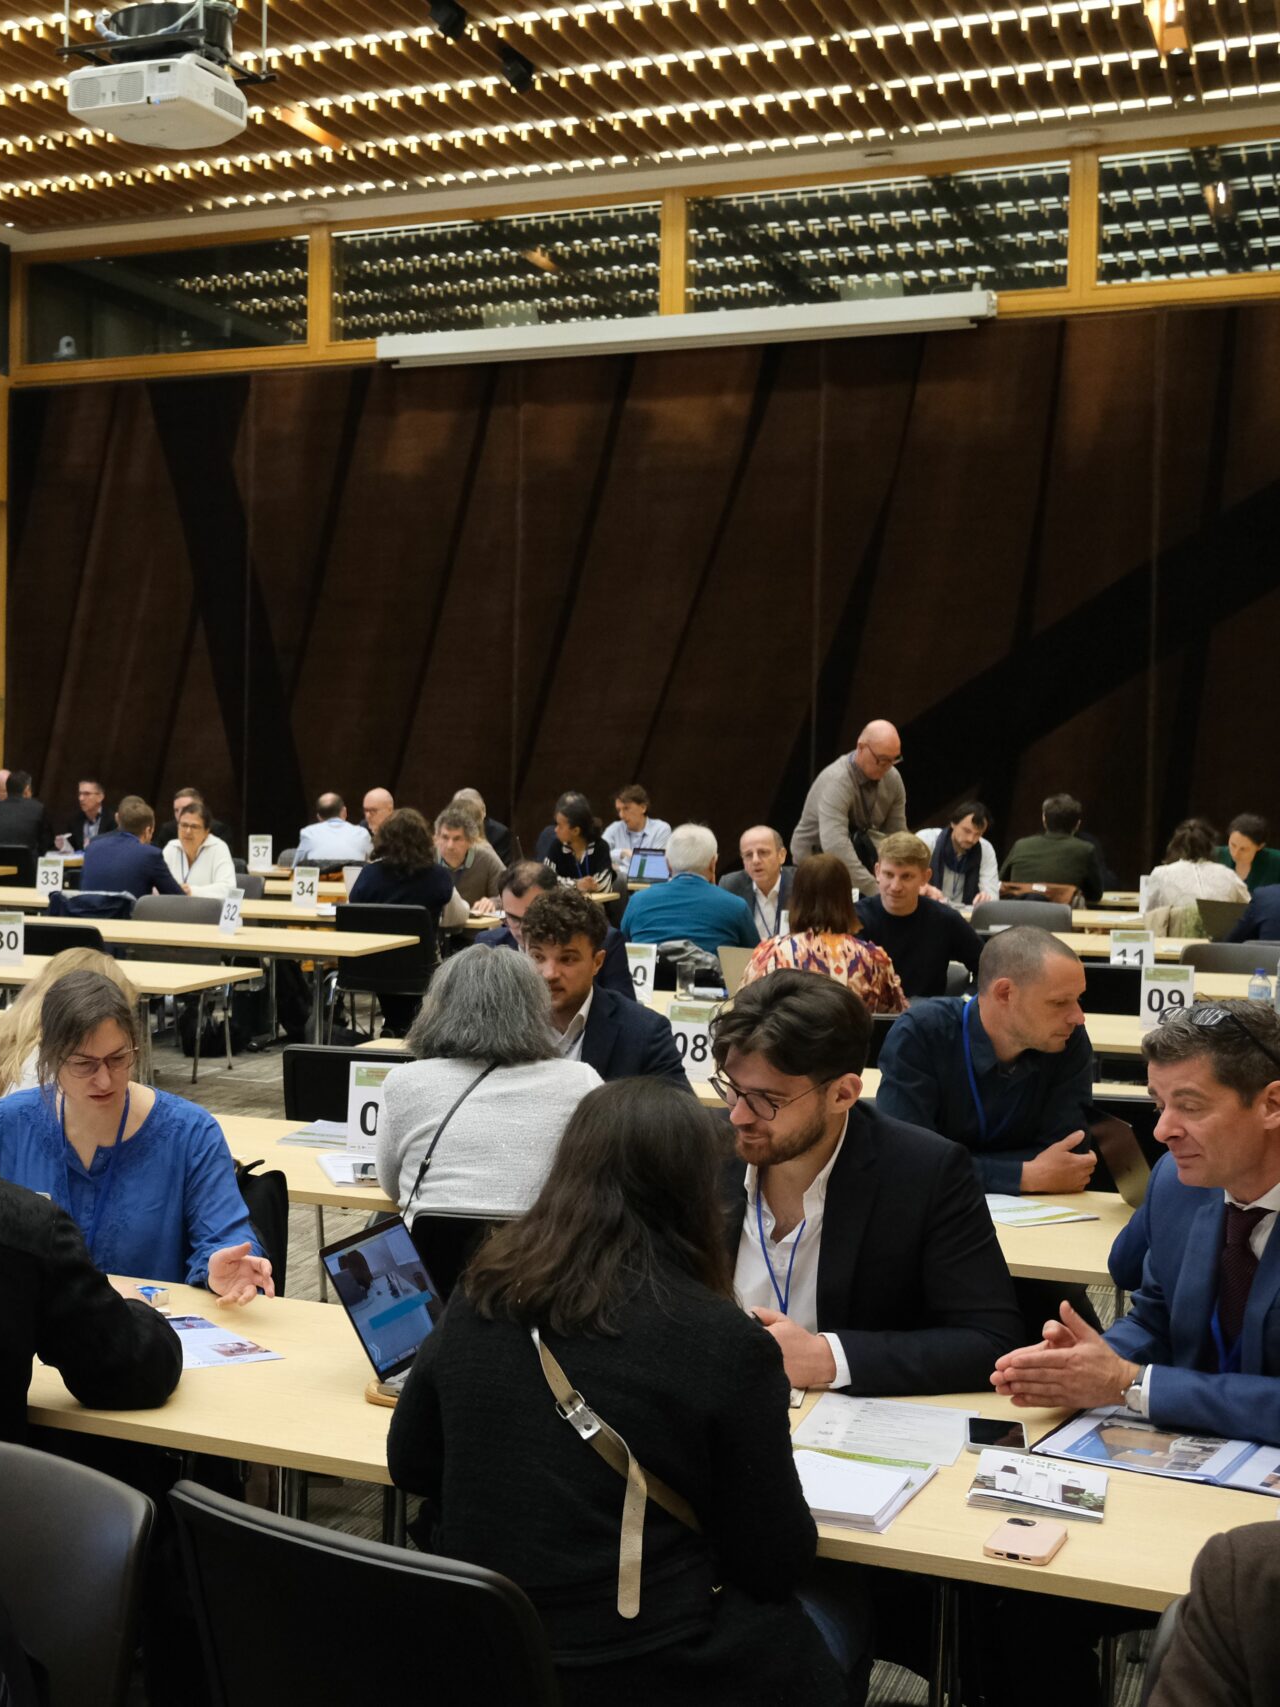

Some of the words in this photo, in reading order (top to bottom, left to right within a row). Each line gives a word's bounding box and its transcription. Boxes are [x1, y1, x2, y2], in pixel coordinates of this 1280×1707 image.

[252, 846, 269, 857] 37
[41, 871, 59, 885] 33
[296, 881, 314, 896] 34
[223, 903, 238, 921] 32
[1146, 988, 1185, 1012] 09
[673, 1032, 708, 1062] 08
